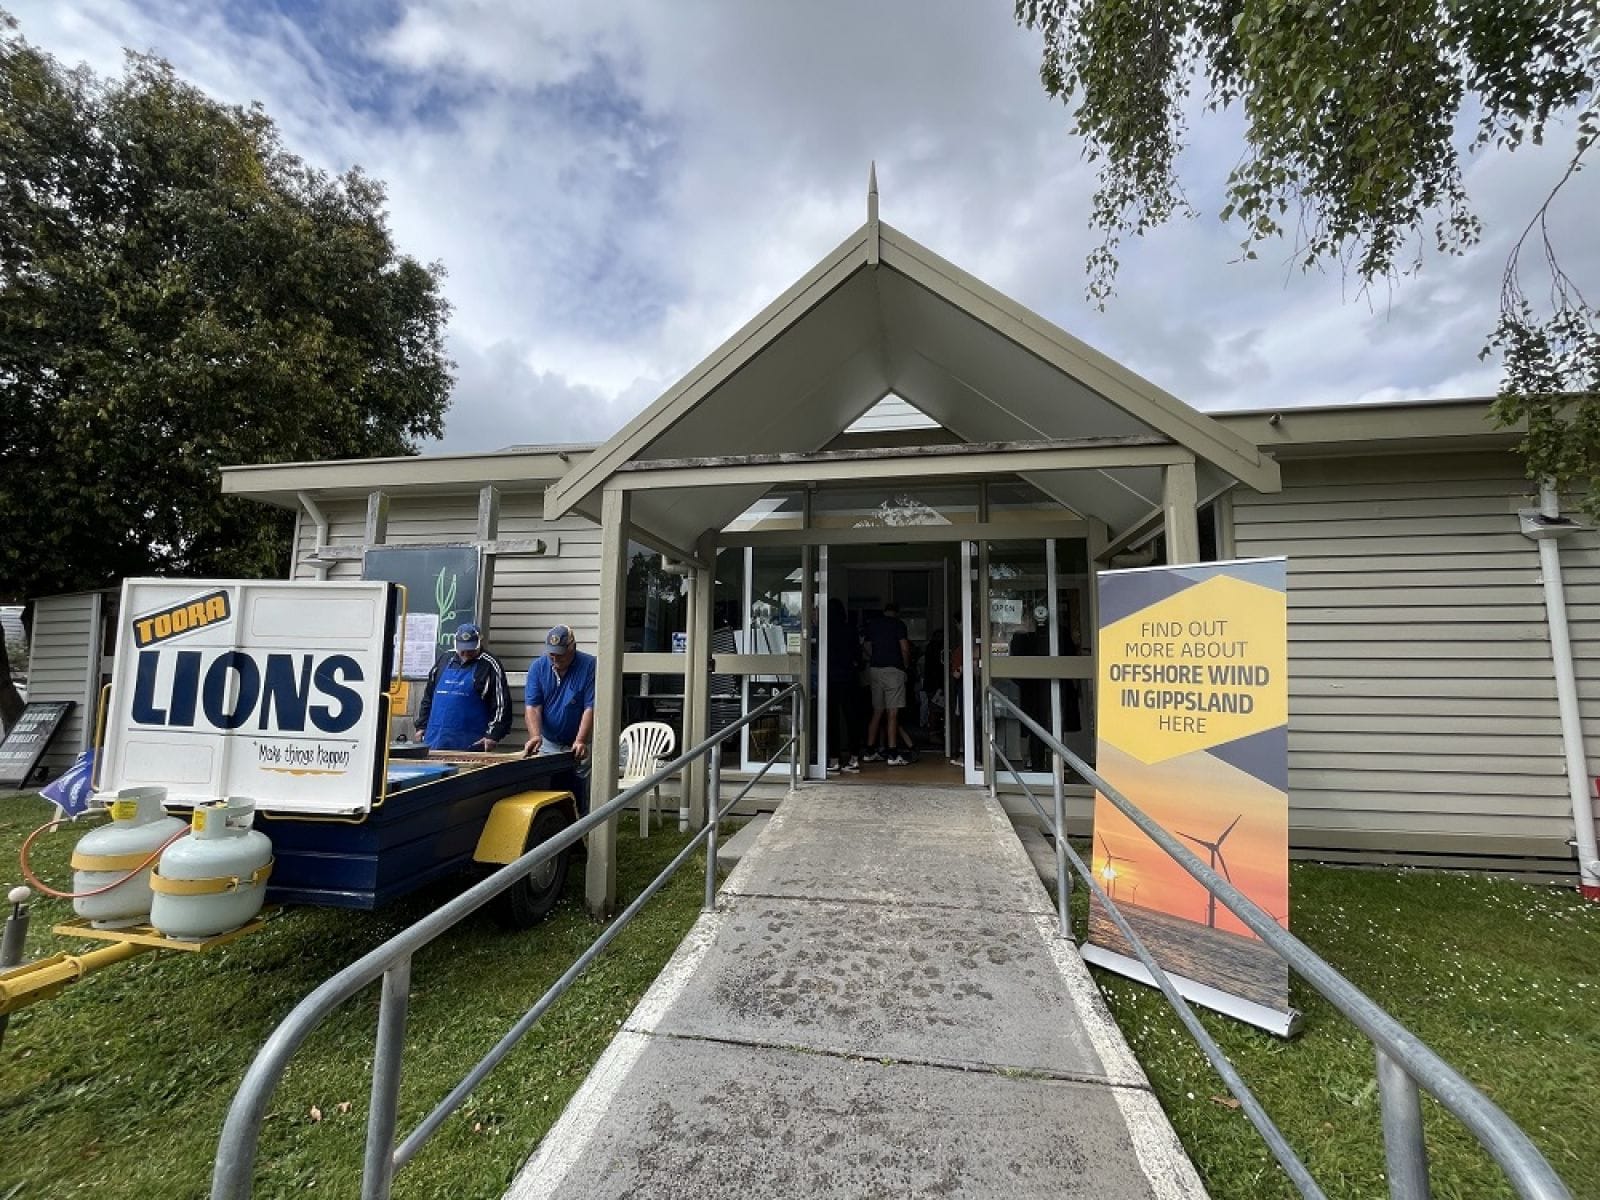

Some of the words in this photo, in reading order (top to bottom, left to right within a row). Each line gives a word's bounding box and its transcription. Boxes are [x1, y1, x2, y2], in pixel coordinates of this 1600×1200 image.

[992, 604, 1015, 612] OPEN
[136, 596, 226, 644] TOORA
[1141, 621, 1183, 638] FIND
[1188, 620, 1228, 637] OUT
[1125, 642, 1175, 658] MORE
[1180, 641, 1248, 658] ABOUT
[1109, 664, 1203, 684] OFFSHORE
[1208, 665, 1270, 687] WIND
[132, 650, 364, 734] LIONS
[1121, 689, 1140, 708] IN
[1143, 690, 1253, 714] GIPPSLAND
[1159, 715, 1207, 734] HERE
[285, 744, 314, 766] things
